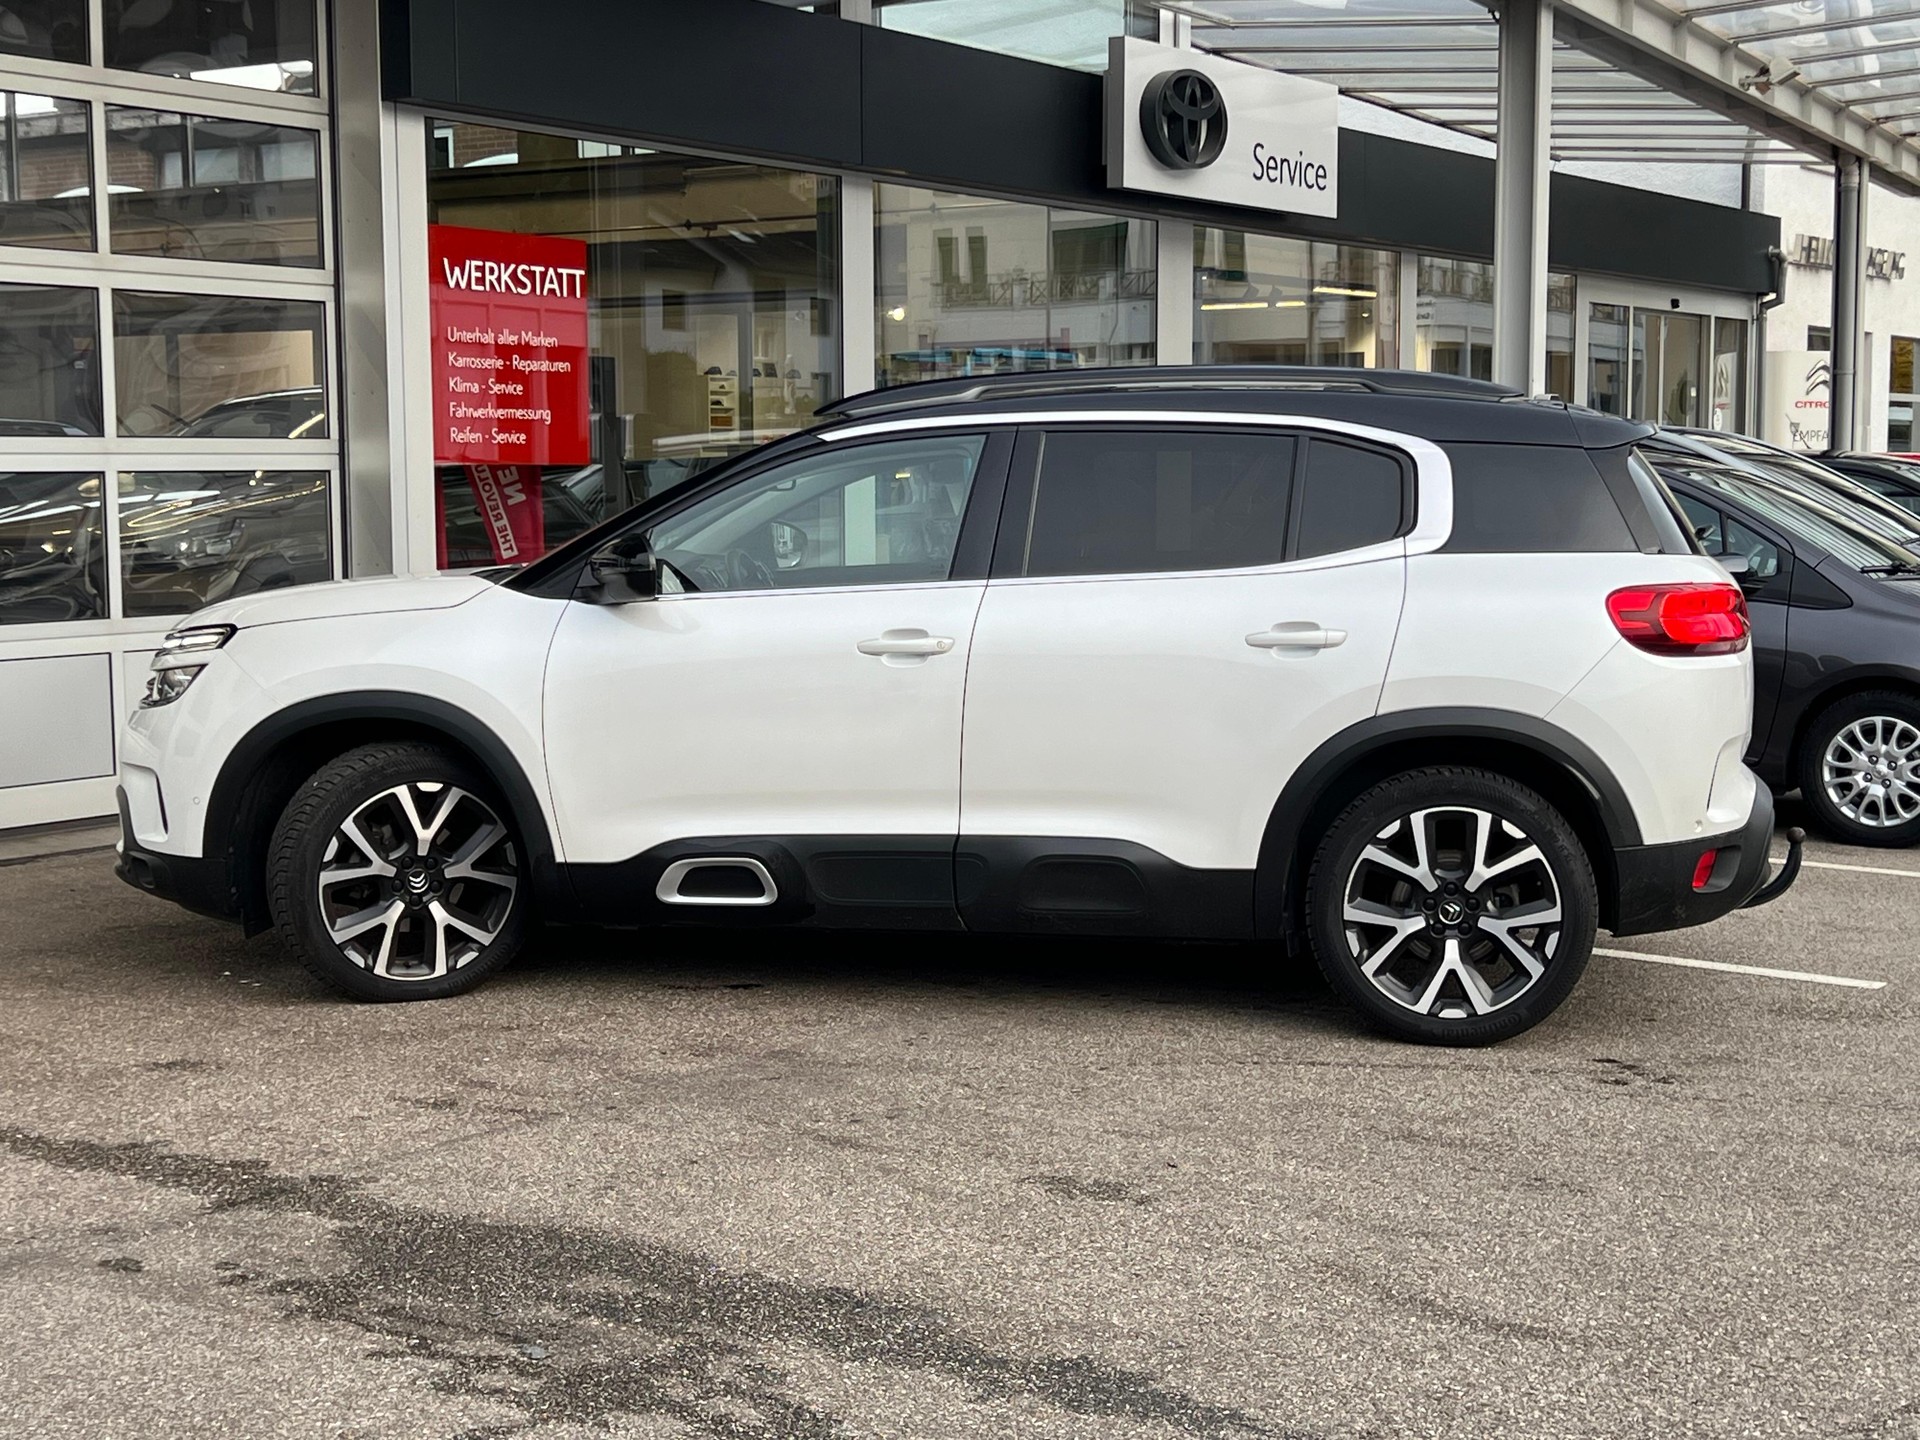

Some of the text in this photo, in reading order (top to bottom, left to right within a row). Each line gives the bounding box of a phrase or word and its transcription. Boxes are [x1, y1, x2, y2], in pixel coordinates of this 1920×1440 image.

[1253, 143, 1327, 191] Service
[443, 258, 585, 298] WERKSTATT
[447, 327, 558, 348] Unterhalt aller Marken
[448, 352, 504, 369] Karrosserie
[512, 355, 571, 374] Reparaturen
[449, 377, 479, 393] Klima
[488, 379, 524, 395] Service
[449, 402, 551, 425] Fahrwerkvermessung
[450, 427, 482, 443] Reifen
[491, 429, 527, 444] Service
